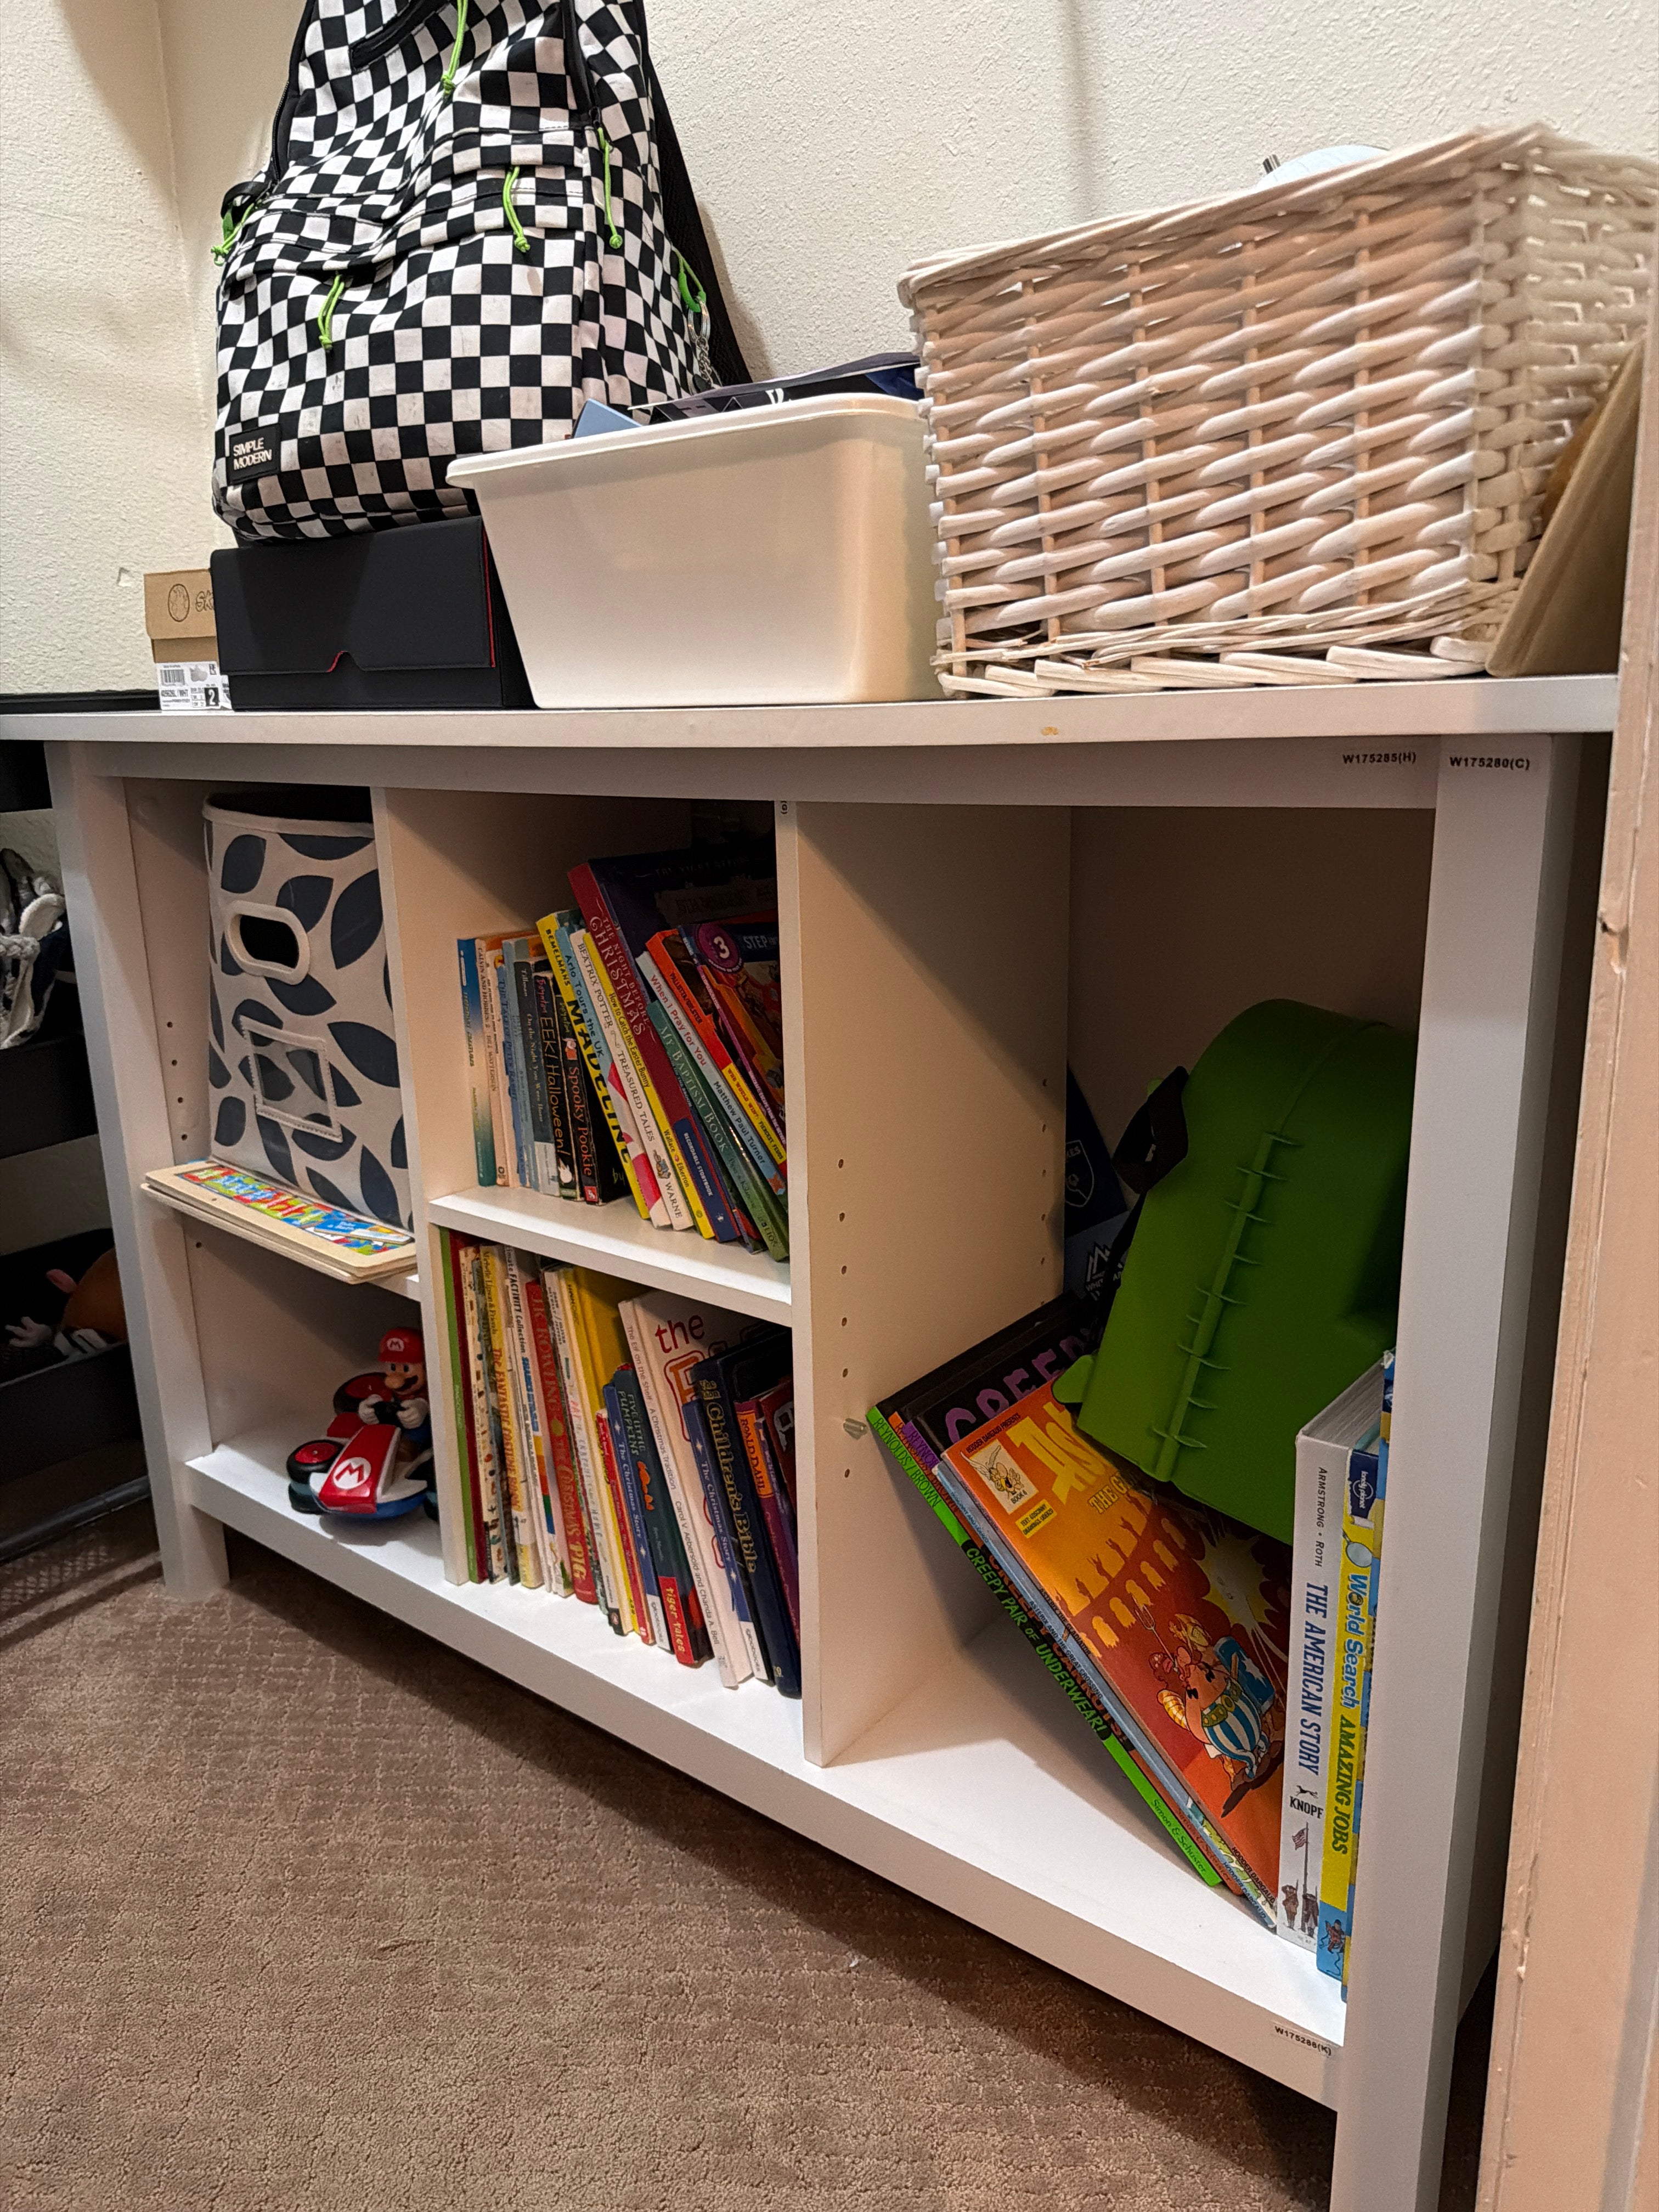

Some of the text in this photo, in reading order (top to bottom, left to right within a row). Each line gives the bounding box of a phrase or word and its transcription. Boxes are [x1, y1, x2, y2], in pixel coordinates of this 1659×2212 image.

[233, 437, 264, 456] SIMPLE
[233, 449, 272, 470] MODERN
[208, 689, 216, 705] 2
[1342, 752, 1417, 764] W175285(H)
[546, 929, 571, 987] BEMELMANS
[714, 936, 730, 960] 3
[743, 935, 768, 950] STEP
[589, 916, 647, 1036] CHRISTMAS
[603, 917, 651, 1025] THE NIGHT BEFORE
[565, 955, 605, 1058] Arlo Tours the UK
[650, 974, 669, 1004] When
[670, 1009, 686, 1032] Pray
[685, 1032, 695, 1046] for
[693, 1047, 708, 1067] You
[577, 942, 656, 1143] BEATRIX POTTER TREASURED TALES
[608, 992, 651, 1088] How to Catch the Easter Bunny
[539, 1017, 571, 1156] EEK! Halloween!
[660, 1025, 729, 1152] MY BAPTISM BOOK
[567, 1067, 592, 1176] Spooky Pookie
[714, 1080, 766, 1164] Matthew Paul Turner
[726, 1068, 737, 1082] WHO
[758, 1120, 775, 1143] FIERCEST
[772, 1143, 785, 1160] FEUDS
[663, 1128, 676, 1153] Wallace
[676, 1163, 690, 1188] Elkerton
[684, 1132, 714, 1197] RECORDABLE STORYBOOK
[665, 1182, 683, 1219] WARNE
[482, 1251, 492, 1279] Michelle
[490, 1310, 498, 1335] Friends
[510, 1273, 521, 1312] FACTIVITY
[388, 1340, 402, 1351] M
[515, 1315, 526, 1353] Collection
[631, 1342, 639, 1351] Elf
[654, 1315, 705, 1354] the
[493, 1348, 502, 1367] The
[634, 1353, 641, 1364] on
[637, 1366, 646, 1381] the
[495, 1370, 512, 1425] FANTASTIC
[641, 1381, 653, 1403] Shelf
[618, 1391, 639, 1456] PUMPKINS
[651, 1415, 666, 1452] Christmas
[335, 1462, 364, 1483] M
[663, 1452, 676, 1490] Tradition
[740, 1418, 766, 1492] ROALD DAHL
[873, 1417, 912, 1470] REYNOLDS
[910, 1470, 943, 1509] BROWN
[618, 1443, 642, 1540] The Christmas Story
[706, 1402, 758, 1573] Children's Bible
[1011, 1492, 1025, 1504] BOOK
[1088, 1485, 1114, 1514] THE
[1358, 1470, 1369, 1509] lonely planet
[675, 1499, 685, 1523] Carol
[701, 1461, 731, 1562] The Christmas Story
[1314, 1466, 1328, 1568] ARMSTRONG ROTH
[569, 1542, 588, 1582] PIG
[683, 1532, 699, 1572] Aebersold
[695, 1572, 704, 1588] and
[663, 1587, 686, 1653] tiger tales
[699, 1588, 713, 1619] Chanda
[1039, 1587, 1092, 1656] ASTERIX THE GLADIATOR
[712, 1630, 720, 1645] Bell
[966, 1548, 1109, 1734] CREEPY PAIR OF UNDERWEAR!
[1029, 1600, 1104, 1700] ASTERIX AND THE GREAT CROSSING
[1298, 1582, 1329, 1776] THE AMERICAN STORY
[1331, 1572, 1368, 1855] World Search AMAZING JOBS
[1289, 1795, 1324, 1820] KNOPF
[1152, 1799, 1207, 1874] Simon & Schuster
[1223, 1862, 1267, 1920] HODDER DARGAUD
[1232, 1846, 1276, 1905] HODDER DARGAUD
[1274, 2025, 1332, 2056] W175288(K)
